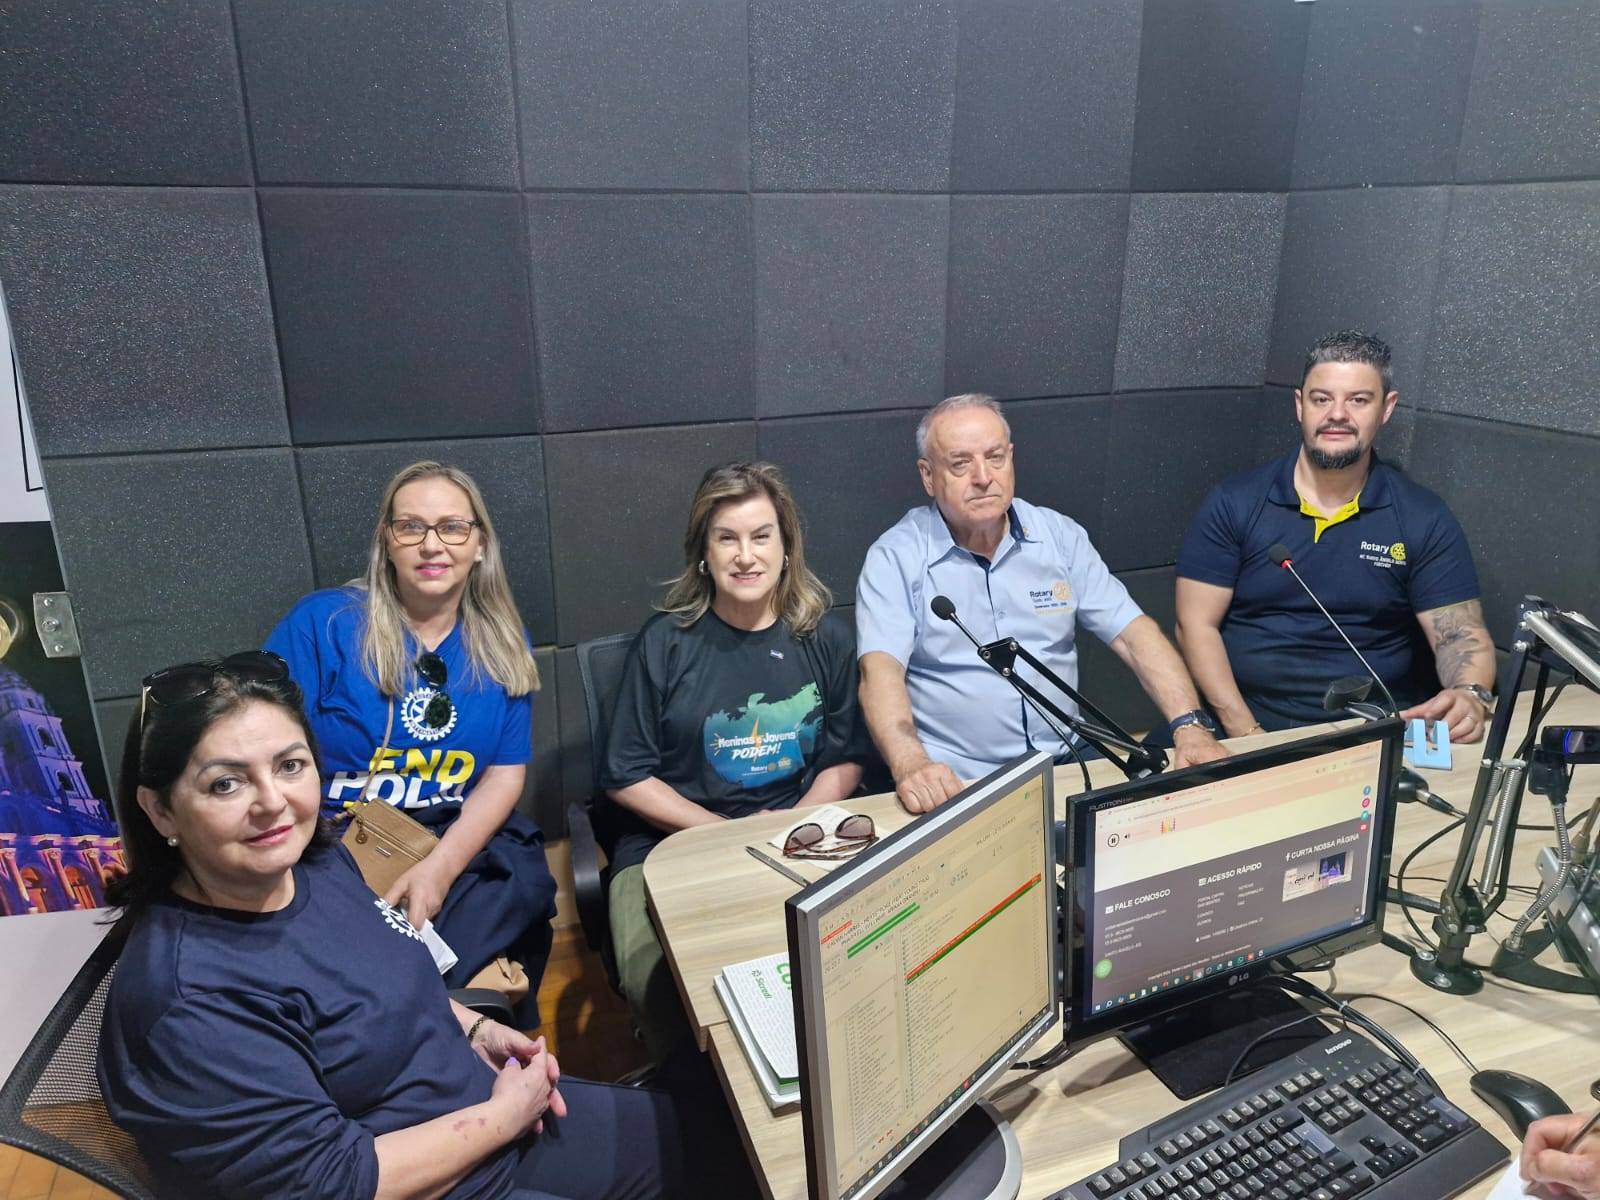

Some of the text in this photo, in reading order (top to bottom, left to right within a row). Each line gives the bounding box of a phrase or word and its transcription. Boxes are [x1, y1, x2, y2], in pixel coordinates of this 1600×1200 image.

[1360, 541, 1390, 554] Rotary
[718, 735, 755, 748] Meninas
[763, 732, 796, 743] Jovens
[731, 742, 781, 761] PODEM!
[369, 747, 475, 784] END
[1291, 847, 1312, 859] CURTA
[1313, 840, 1336, 852] NOSSA
[1336, 833, 1360, 846] PÁGINA
[1207, 862, 1262, 884] ACESSO RÁPIDO
[1114, 888, 1171, 911] FALE CONOSCO
[1238, 972, 1250, 981] LG
[755, 976, 772, 999] Sicredi
[1325, 1039, 1352, 1055] lenovo
